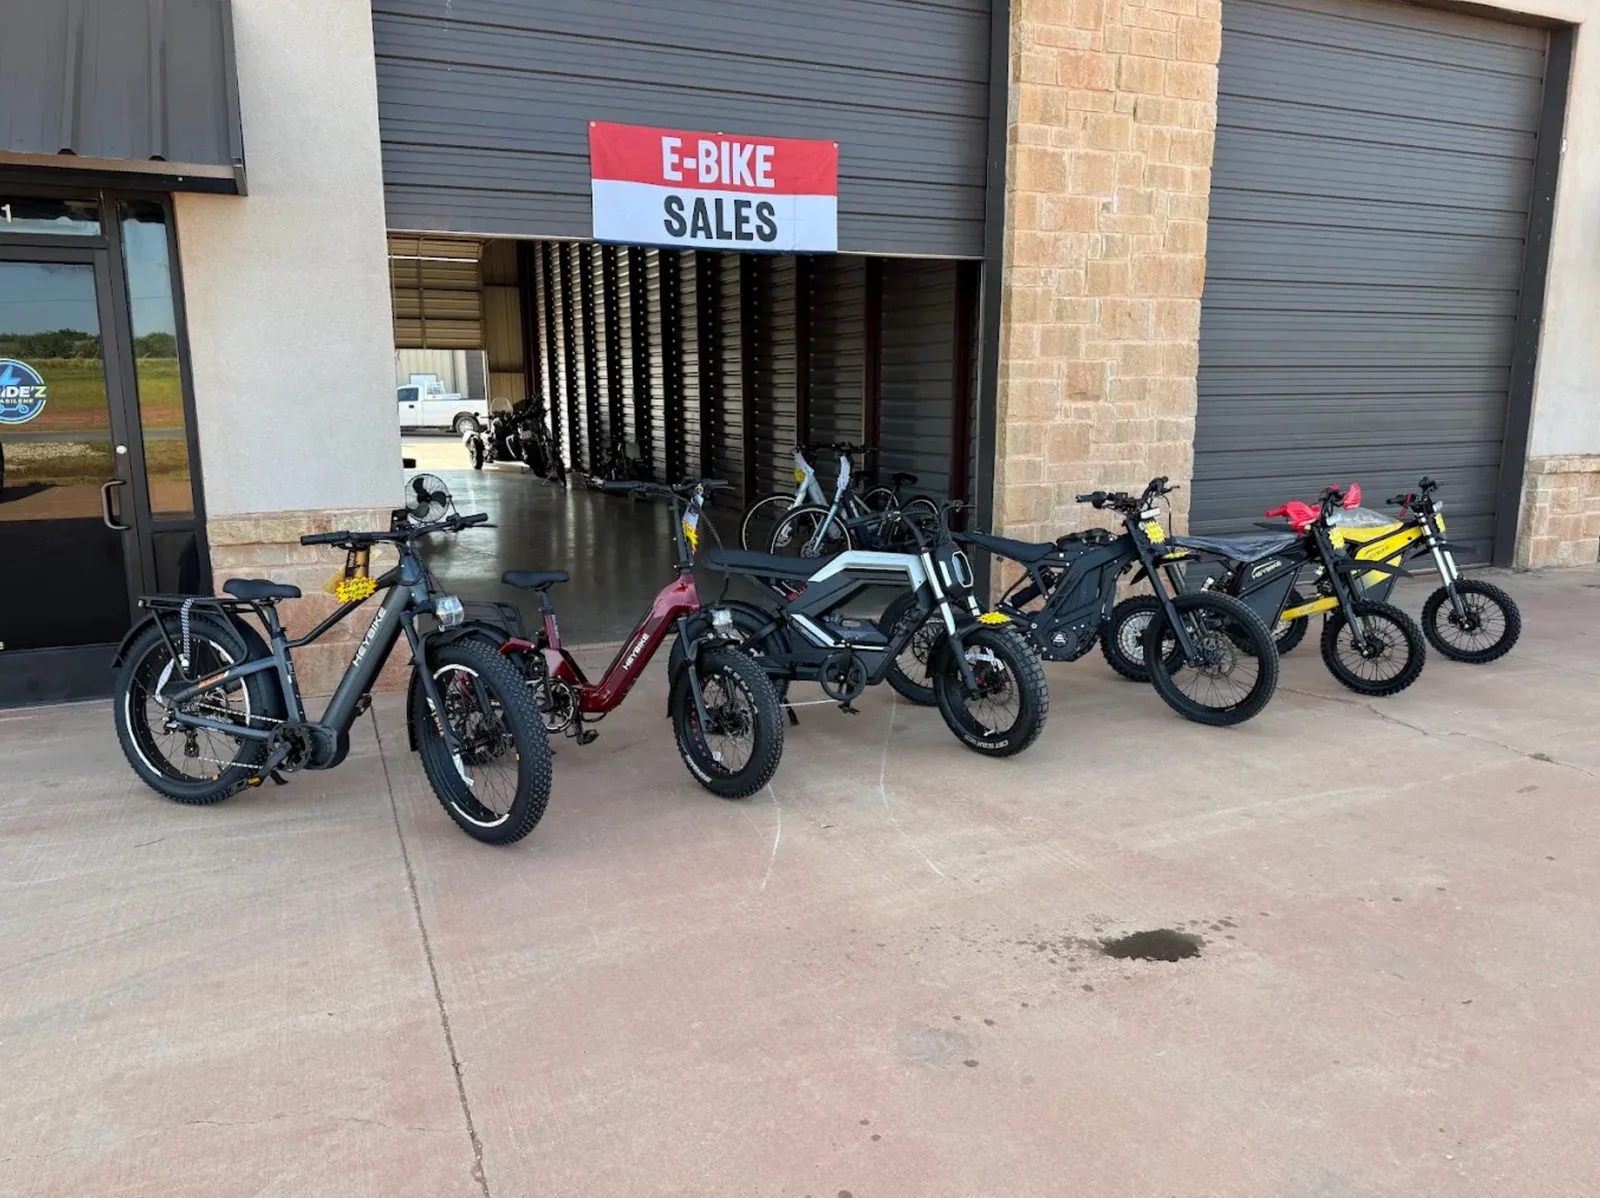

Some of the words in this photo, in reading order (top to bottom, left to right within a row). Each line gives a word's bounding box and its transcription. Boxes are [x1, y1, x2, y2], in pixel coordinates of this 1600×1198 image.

[661, 136, 775, 188] E-BIKE
[1, 204, 12, 223] 1
[663, 195, 778, 242] SALES
[0, 386, 47, 398] IDE'Z
[352, 607, 387, 667] HEYBIKE
[622, 632, 650, 671] HEYBIKE
